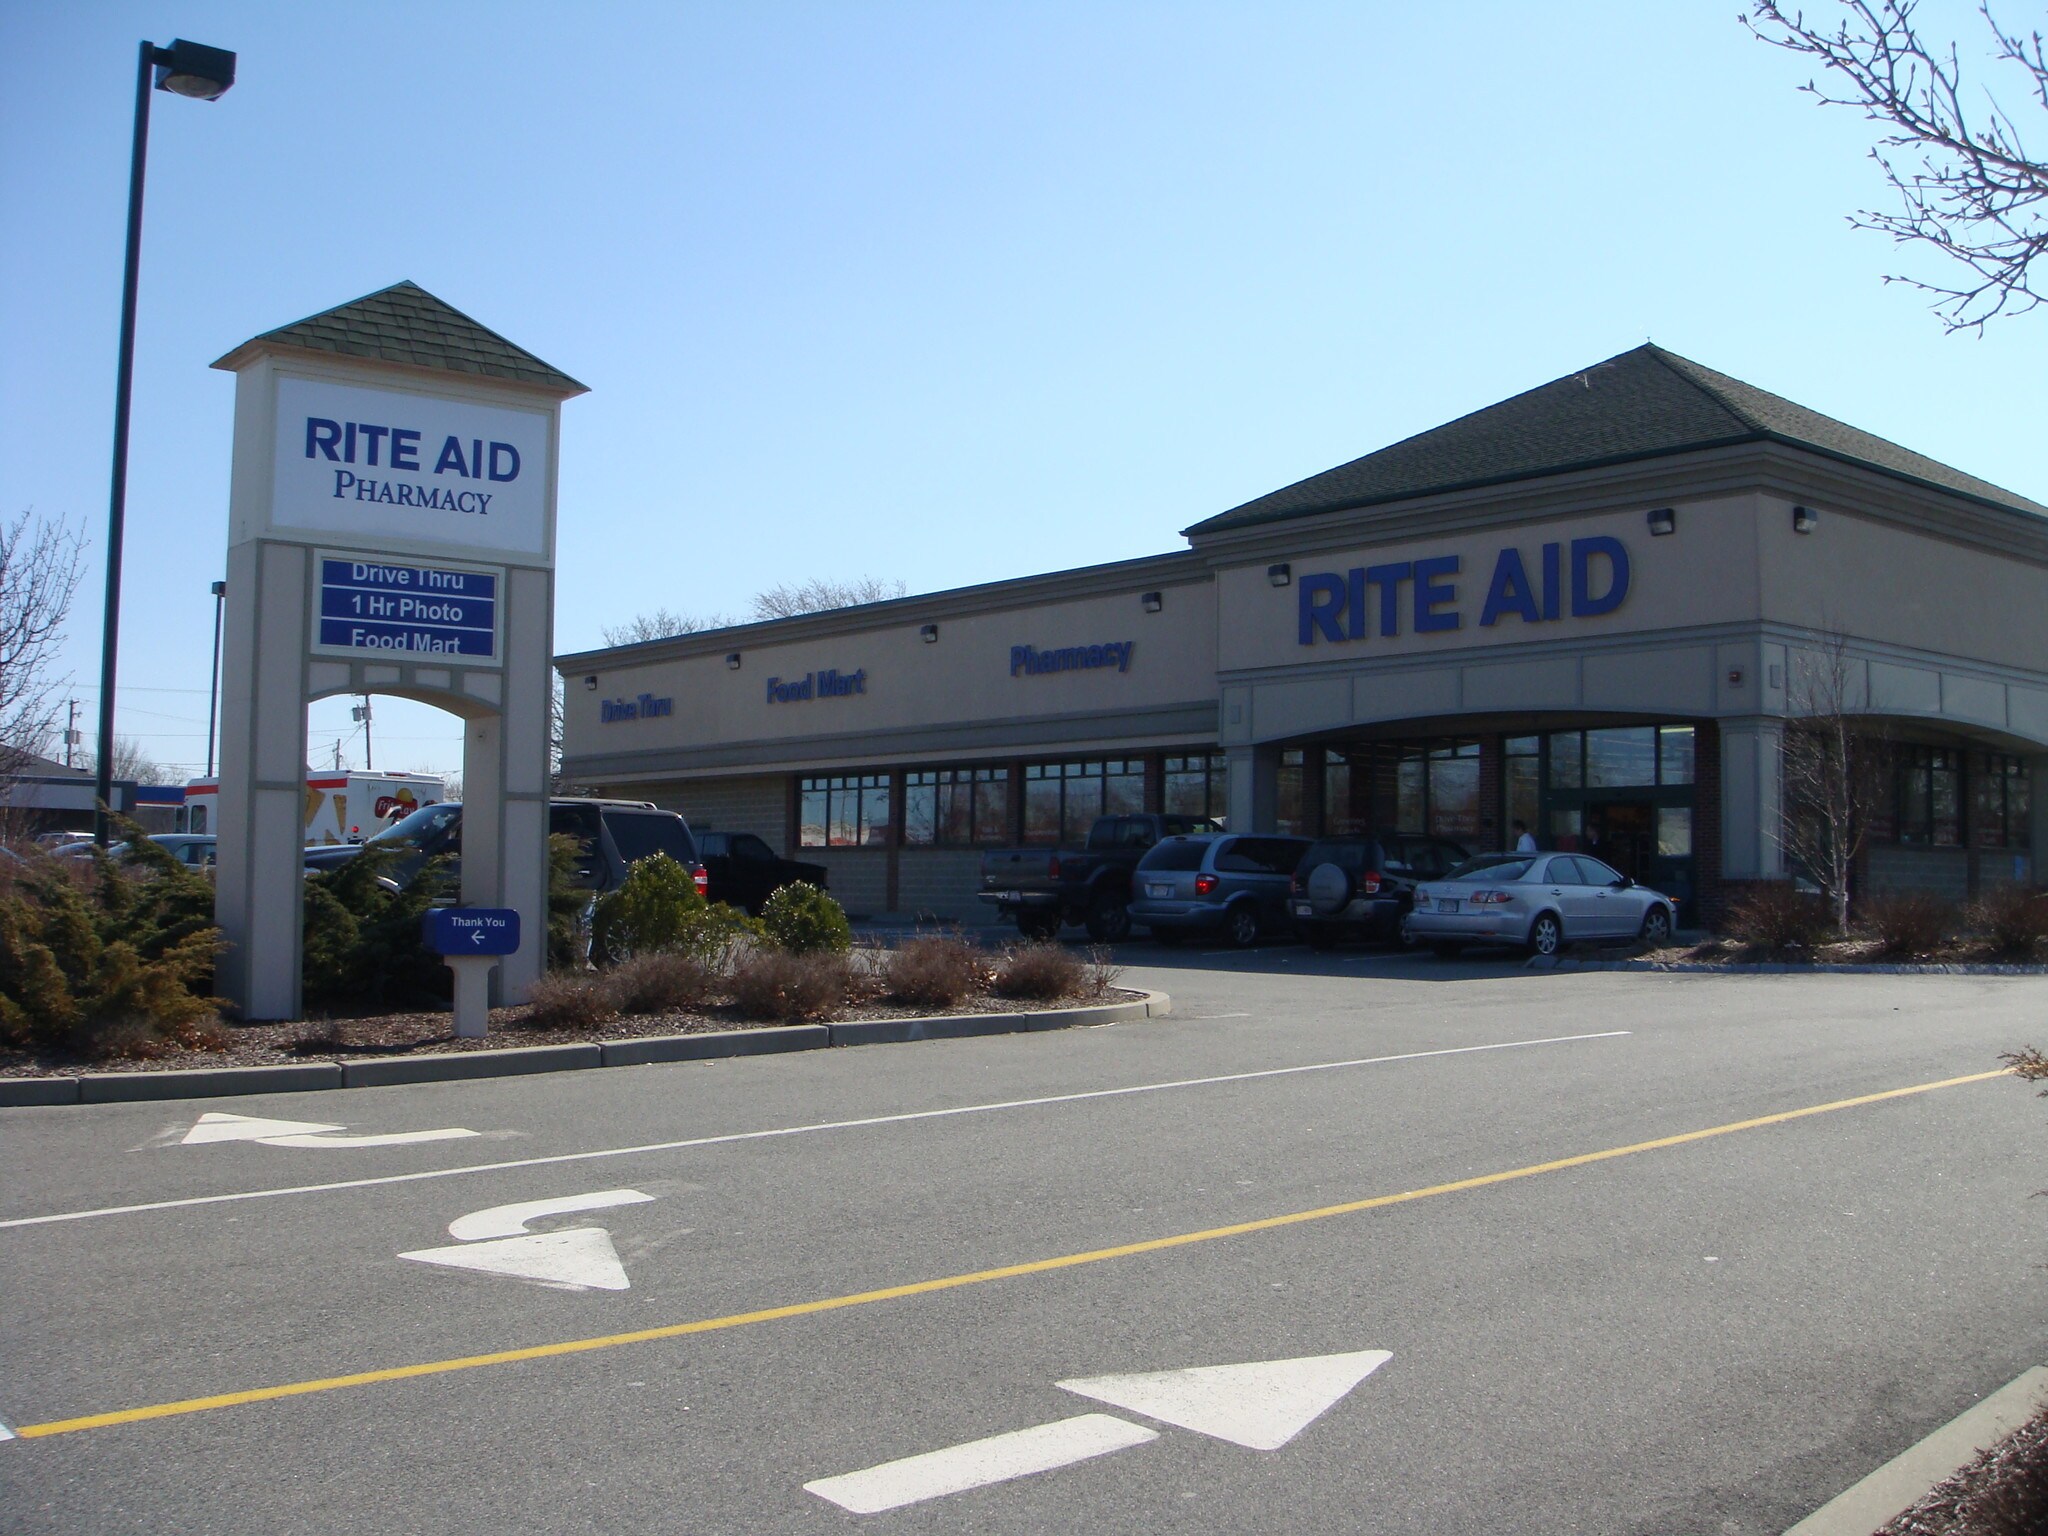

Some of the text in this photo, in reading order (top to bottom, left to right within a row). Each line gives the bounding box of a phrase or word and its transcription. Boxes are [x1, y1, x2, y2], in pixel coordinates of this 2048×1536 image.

[305, 417, 521, 482] RITE AID
[352, 564, 464, 590] Drive Thru
[1298, 536, 1630, 645] RITE AID
[352, 594, 463, 622] 1 Hr Photo
[352, 628, 460, 654] Food Mart
[1010, 640, 1133, 677] Pharmacy
[766, 667, 864, 704] Food Mart
[602, 693, 673, 725] Drive Thru
[451, 917, 505, 927] Thank You
